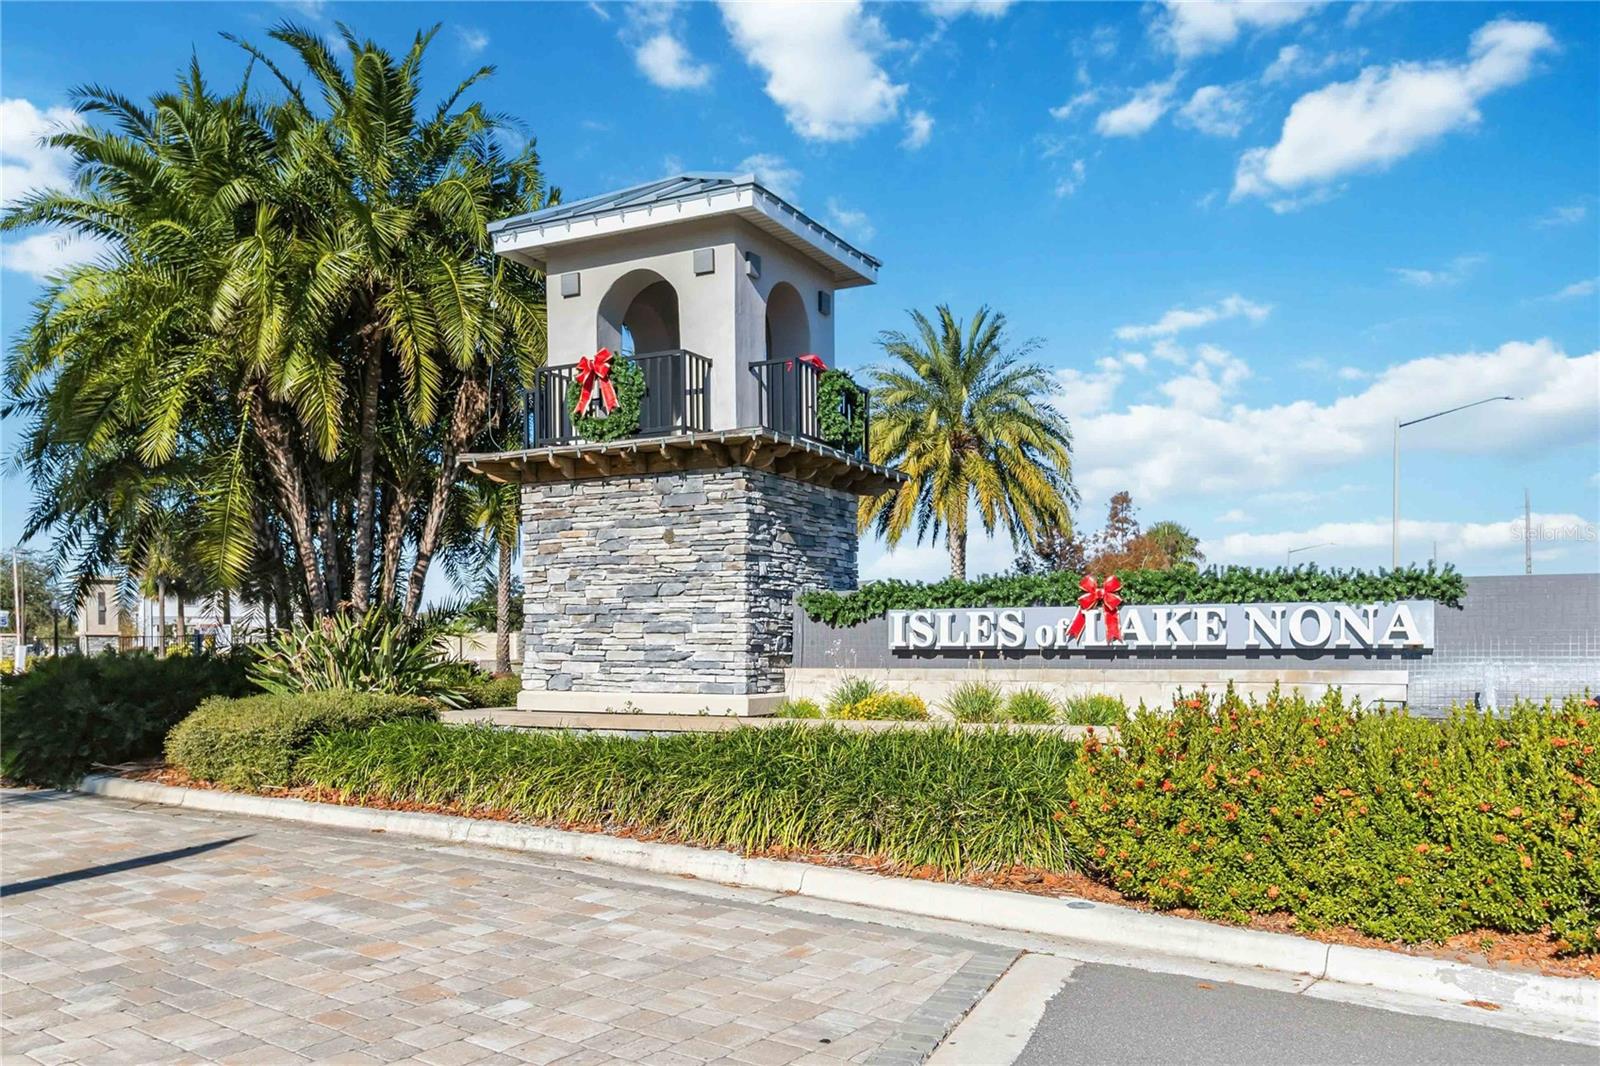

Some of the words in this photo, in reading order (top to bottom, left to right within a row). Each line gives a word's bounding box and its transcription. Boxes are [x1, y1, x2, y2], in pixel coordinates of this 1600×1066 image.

[889, 609, 1026, 648] ISLES
[1034, 618, 1070, 648] of
[1081, 607, 1227, 647] LAKE
[1244, 604, 1425, 648] NONA
